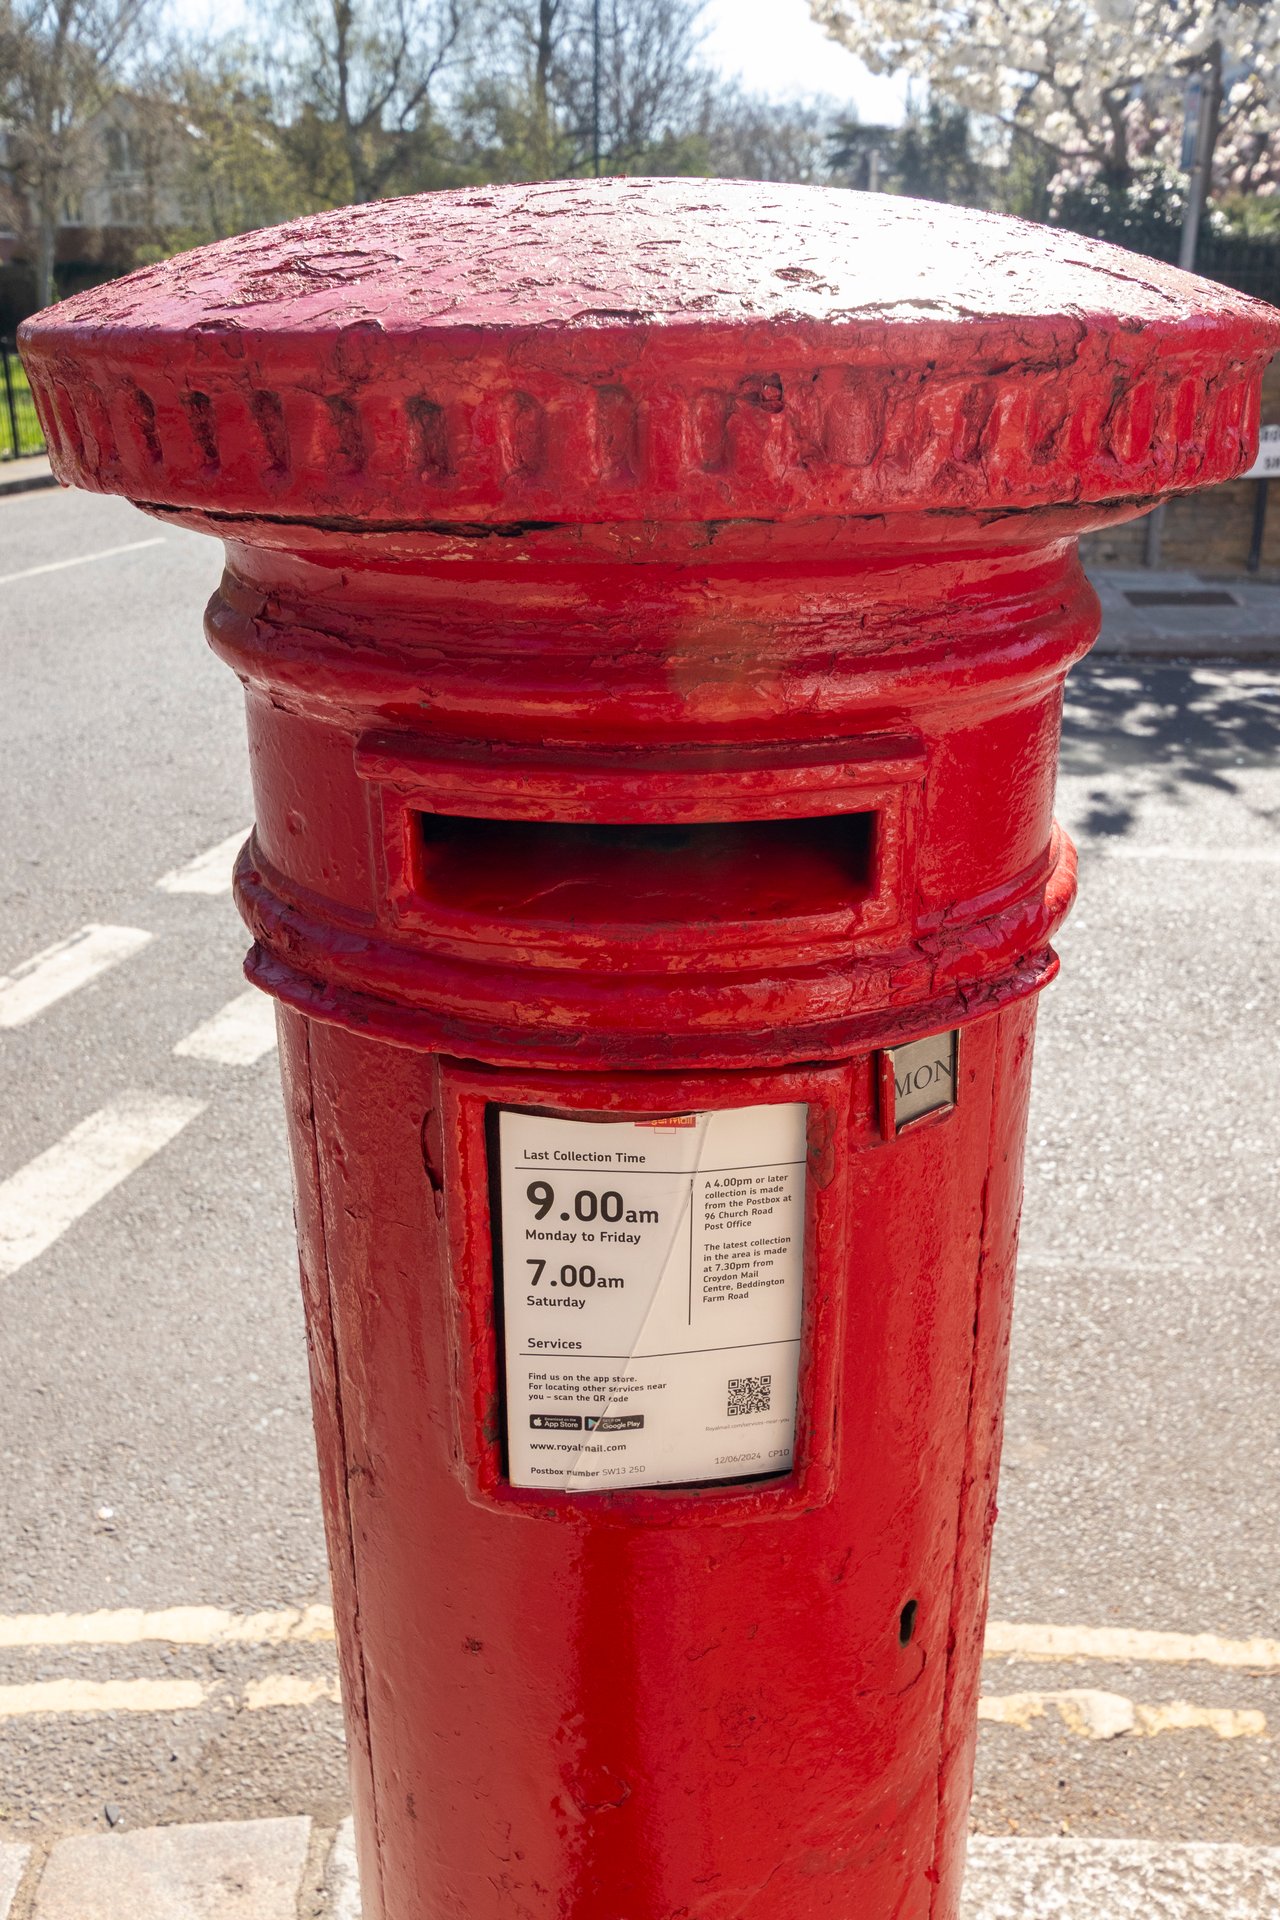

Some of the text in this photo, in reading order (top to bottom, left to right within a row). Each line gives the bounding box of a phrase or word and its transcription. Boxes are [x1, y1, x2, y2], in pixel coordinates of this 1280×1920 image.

[895, 1054, 953, 1100] MON
[524, 1149, 646, 1163] Last Collection Time
[705, 1181, 711, 1189] A
[714, 1177, 752, 1188] 4.00pm
[768, 1174, 788, 1182] later
[705, 1185, 784, 1200] collection is made
[526, 1180, 659, 1223] 9.00am
[704, 1194, 792, 1210] from the Postbox at
[704, 1206, 773, 1220] 96 Church Road
[704, 1219, 752, 1231] Post Office
[525, 1229, 641, 1245] Monday to Friday
[704, 1236, 791, 1251] The latest collection
[703, 1254, 712, 1262] in
[731, 1251, 751, 1259] area
[753, 1249, 761, 1257] is
[763, 1246, 788, 1255] made
[703, 1259, 774, 1273] at 7.30pm from
[526, 1259, 624, 1288] 7.00am
[703, 1270, 759, 1283] Croydon Mail
[703, 1278, 785, 1293] Centre, Beddington
[526, 1295, 586, 1309] Saturday
[702, 1291, 749, 1303] Farm Road
[528, 1337, 582, 1349] Services
[528, 1372, 547, 1380] Find
[576, 1374, 591, 1382] the
[593, 1375, 610, 1383] app
[612, 1375, 637, 1383] store.
[528, 1382, 543, 1390] For
[545, 1383, 580, 1392] locating
[582, 1384, 606, 1392] other
[593, 1394, 606, 1402] QR
[544, 1420, 559, 1428] App
[602, 1422, 626, 1430] Google
[714, 1452, 762, 1465] 12/06/2024
[530, 1467, 564, 1476] Postbox
[566, 1469, 600, 1477] number
[602, 1467, 626, 1476] SW13
